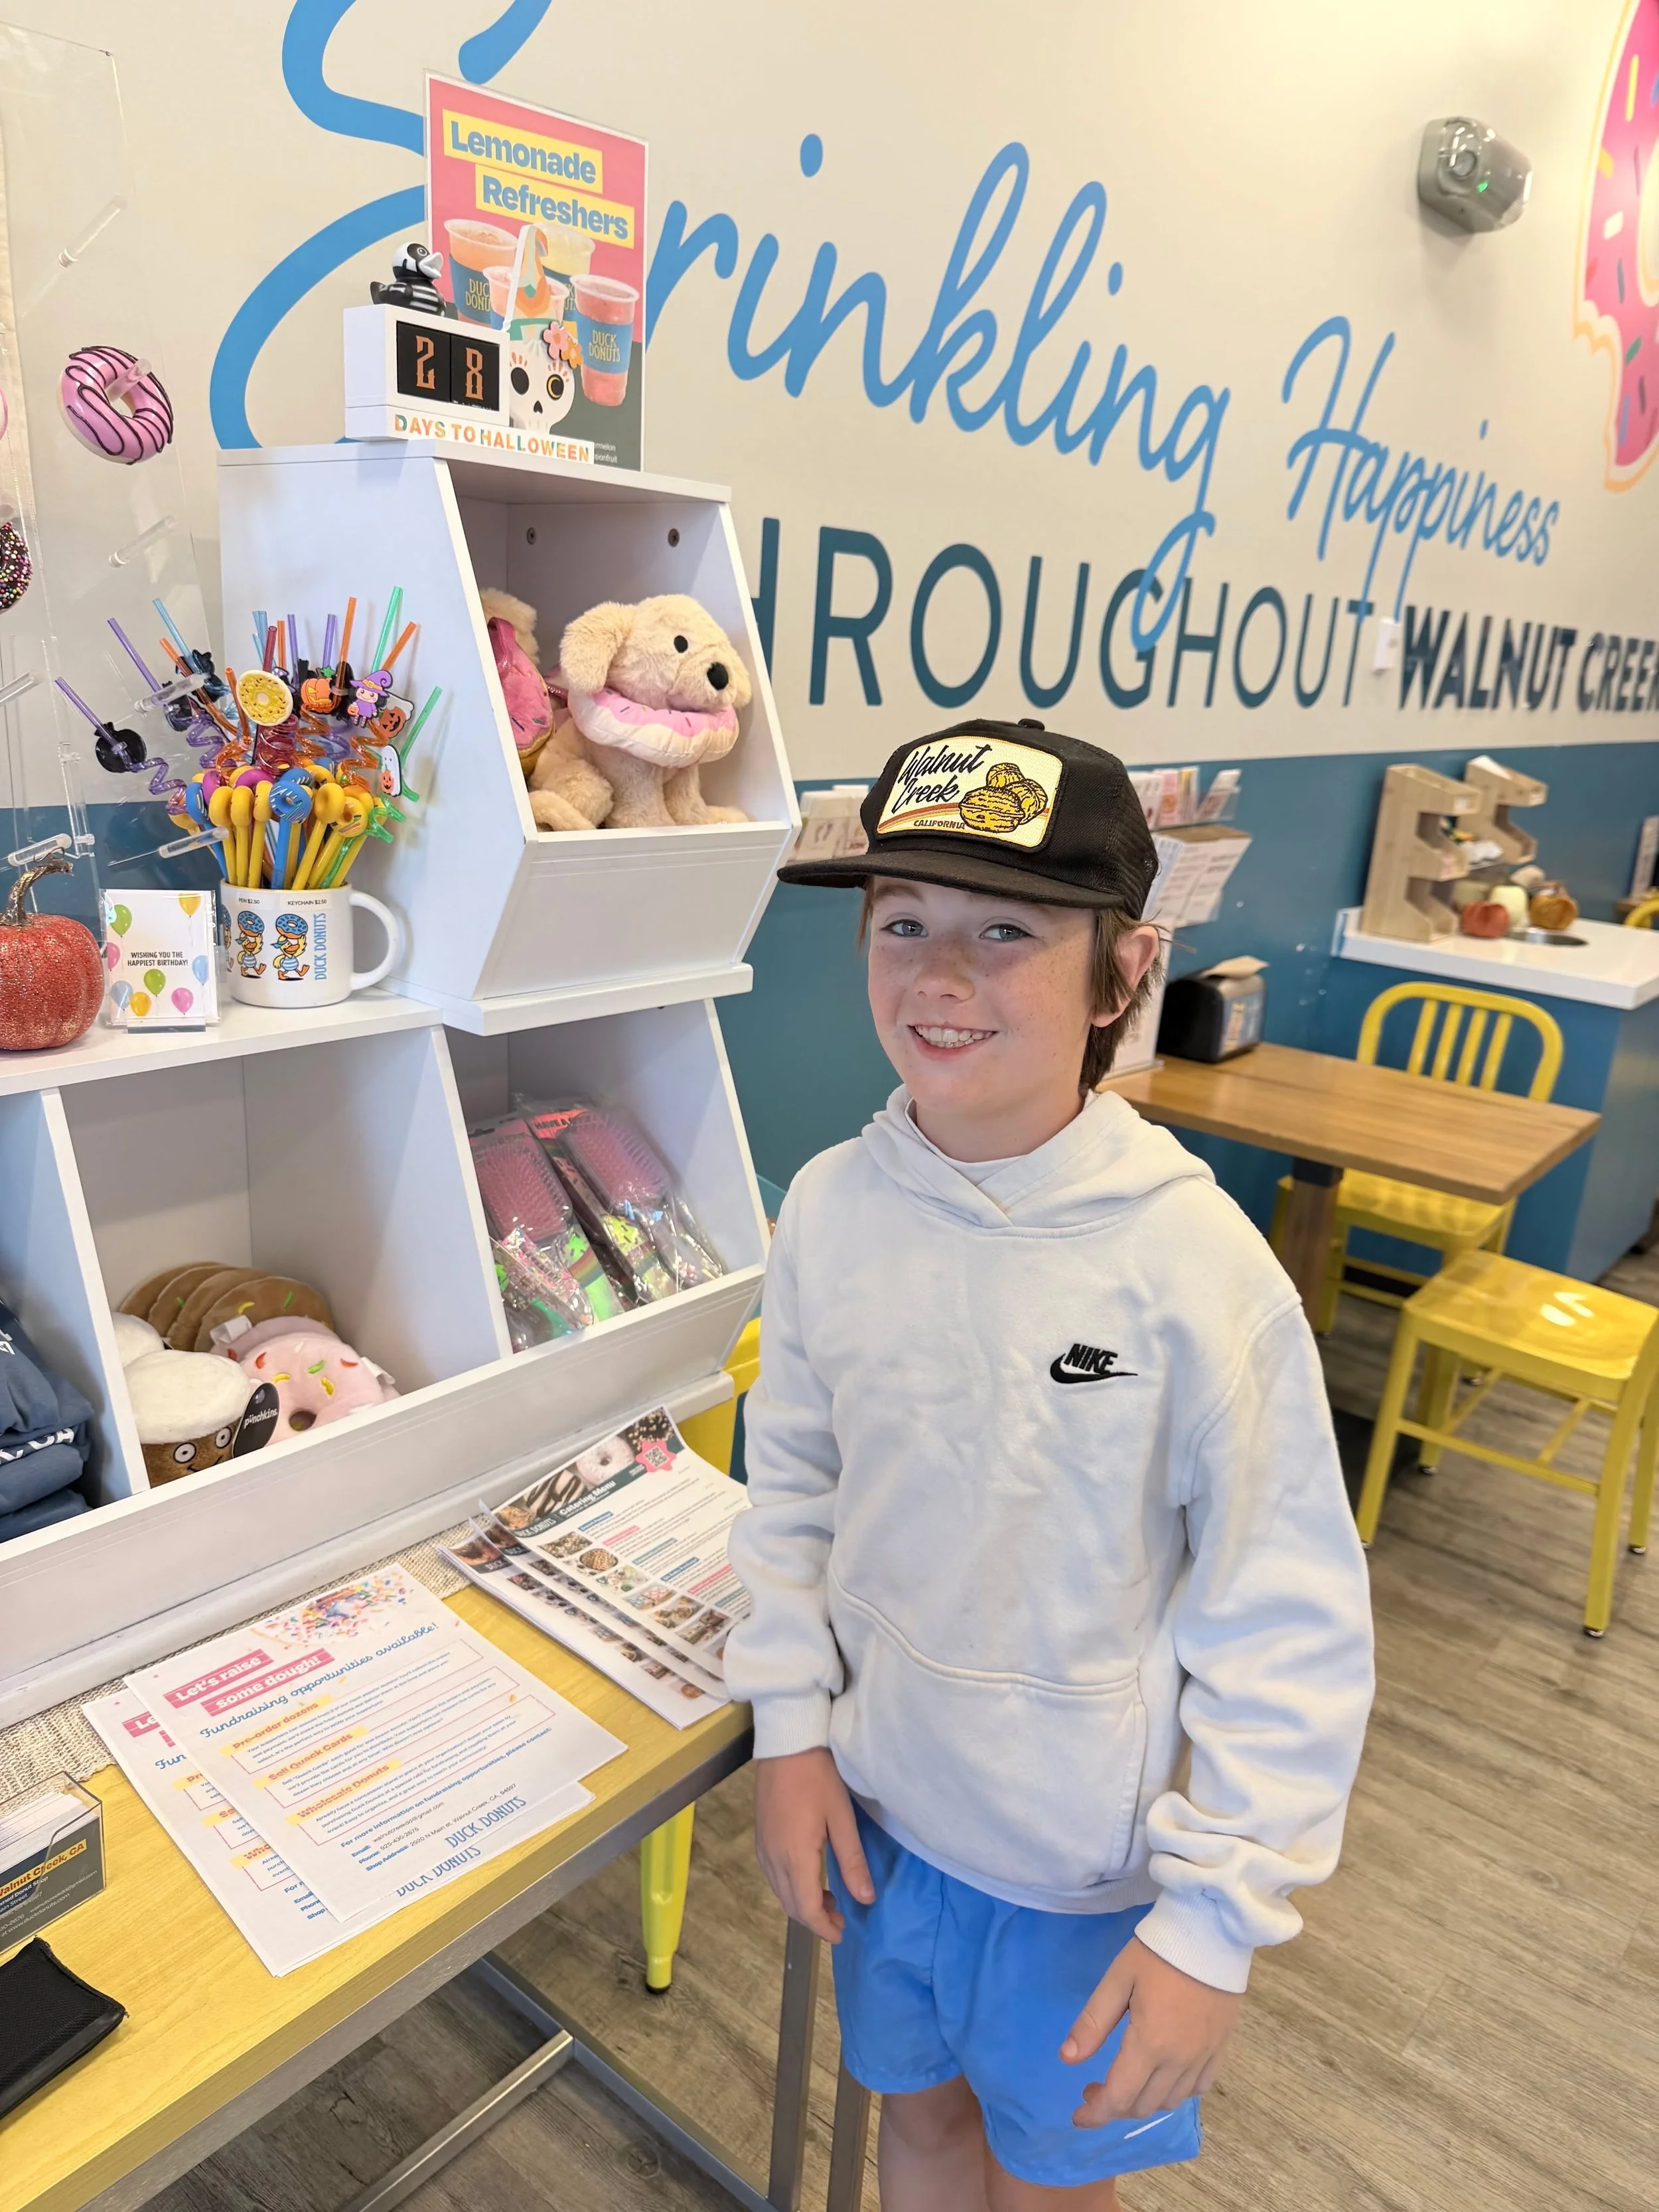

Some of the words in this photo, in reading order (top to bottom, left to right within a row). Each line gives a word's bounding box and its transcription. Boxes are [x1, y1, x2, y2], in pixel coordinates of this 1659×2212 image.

[451, 120, 596, 184] Lemonade
[483, 175, 628, 240] Refreshers
[465, 291, 491, 311] DONU
[469, 278, 490, 298] DUC
[210, 0, 1230, 652] Srinkling
[1281, 316, 1559, 623] Happiness
[592, 330, 617, 348] DUCK
[589, 342, 621, 362] DONUTS
[395, 414, 446, 439] DAYS
[451, 423, 476, 443] TO
[480, 429, 590, 463] HALLOWEEN
[1399, 605, 1579, 711] WALNUT
[898, 744, 993, 786] Walnut
[891, 774, 960, 814] Creek
[913, 820, 965, 830] CALIFORNIA
[313, 913, 327, 952] DONUTS
[314, 953, 327, 981] DUCK
[1063, 1343, 1118, 1374] NIKE
[559, 1489, 597, 1516] Catering
[595, 1479, 616, 1496] Menu
[175, 1676, 220, 1702] Let's
[220, 1655, 261, 1681] raise
[200, 1696, 288, 1737] Fundraising
[291, 1656, 372, 1696] opportunities
[376, 1623, 437, 1655] available!
[216, 1681, 265, 1709] some
[264, 1655, 322, 1687] dough!
[232, 1722, 281, 1749] Pre-order
[283, 1703, 318, 1723] dozens
[268, 1767, 289, 1780] Sell
[289, 1749, 323, 1769] Quack
[323, 1734, 352, 1751] Cards
[297, 1787, 352, 1817] Wholesale
[352, 1765, 389, 1787] Donuts
[354, 1828, 373, 1840] more
[373, 1806, 414, 1828] information
[423, 1779, 462, 1801] fundraising
[505, 1742, 526, 1756] please
[445, 1822, 483, 1848] DUCK
[478, 1796, 526, 1826] DONUTS
[69, 1843, 85, 1856] CA
[15, 1884, 33, 1897] Donut
